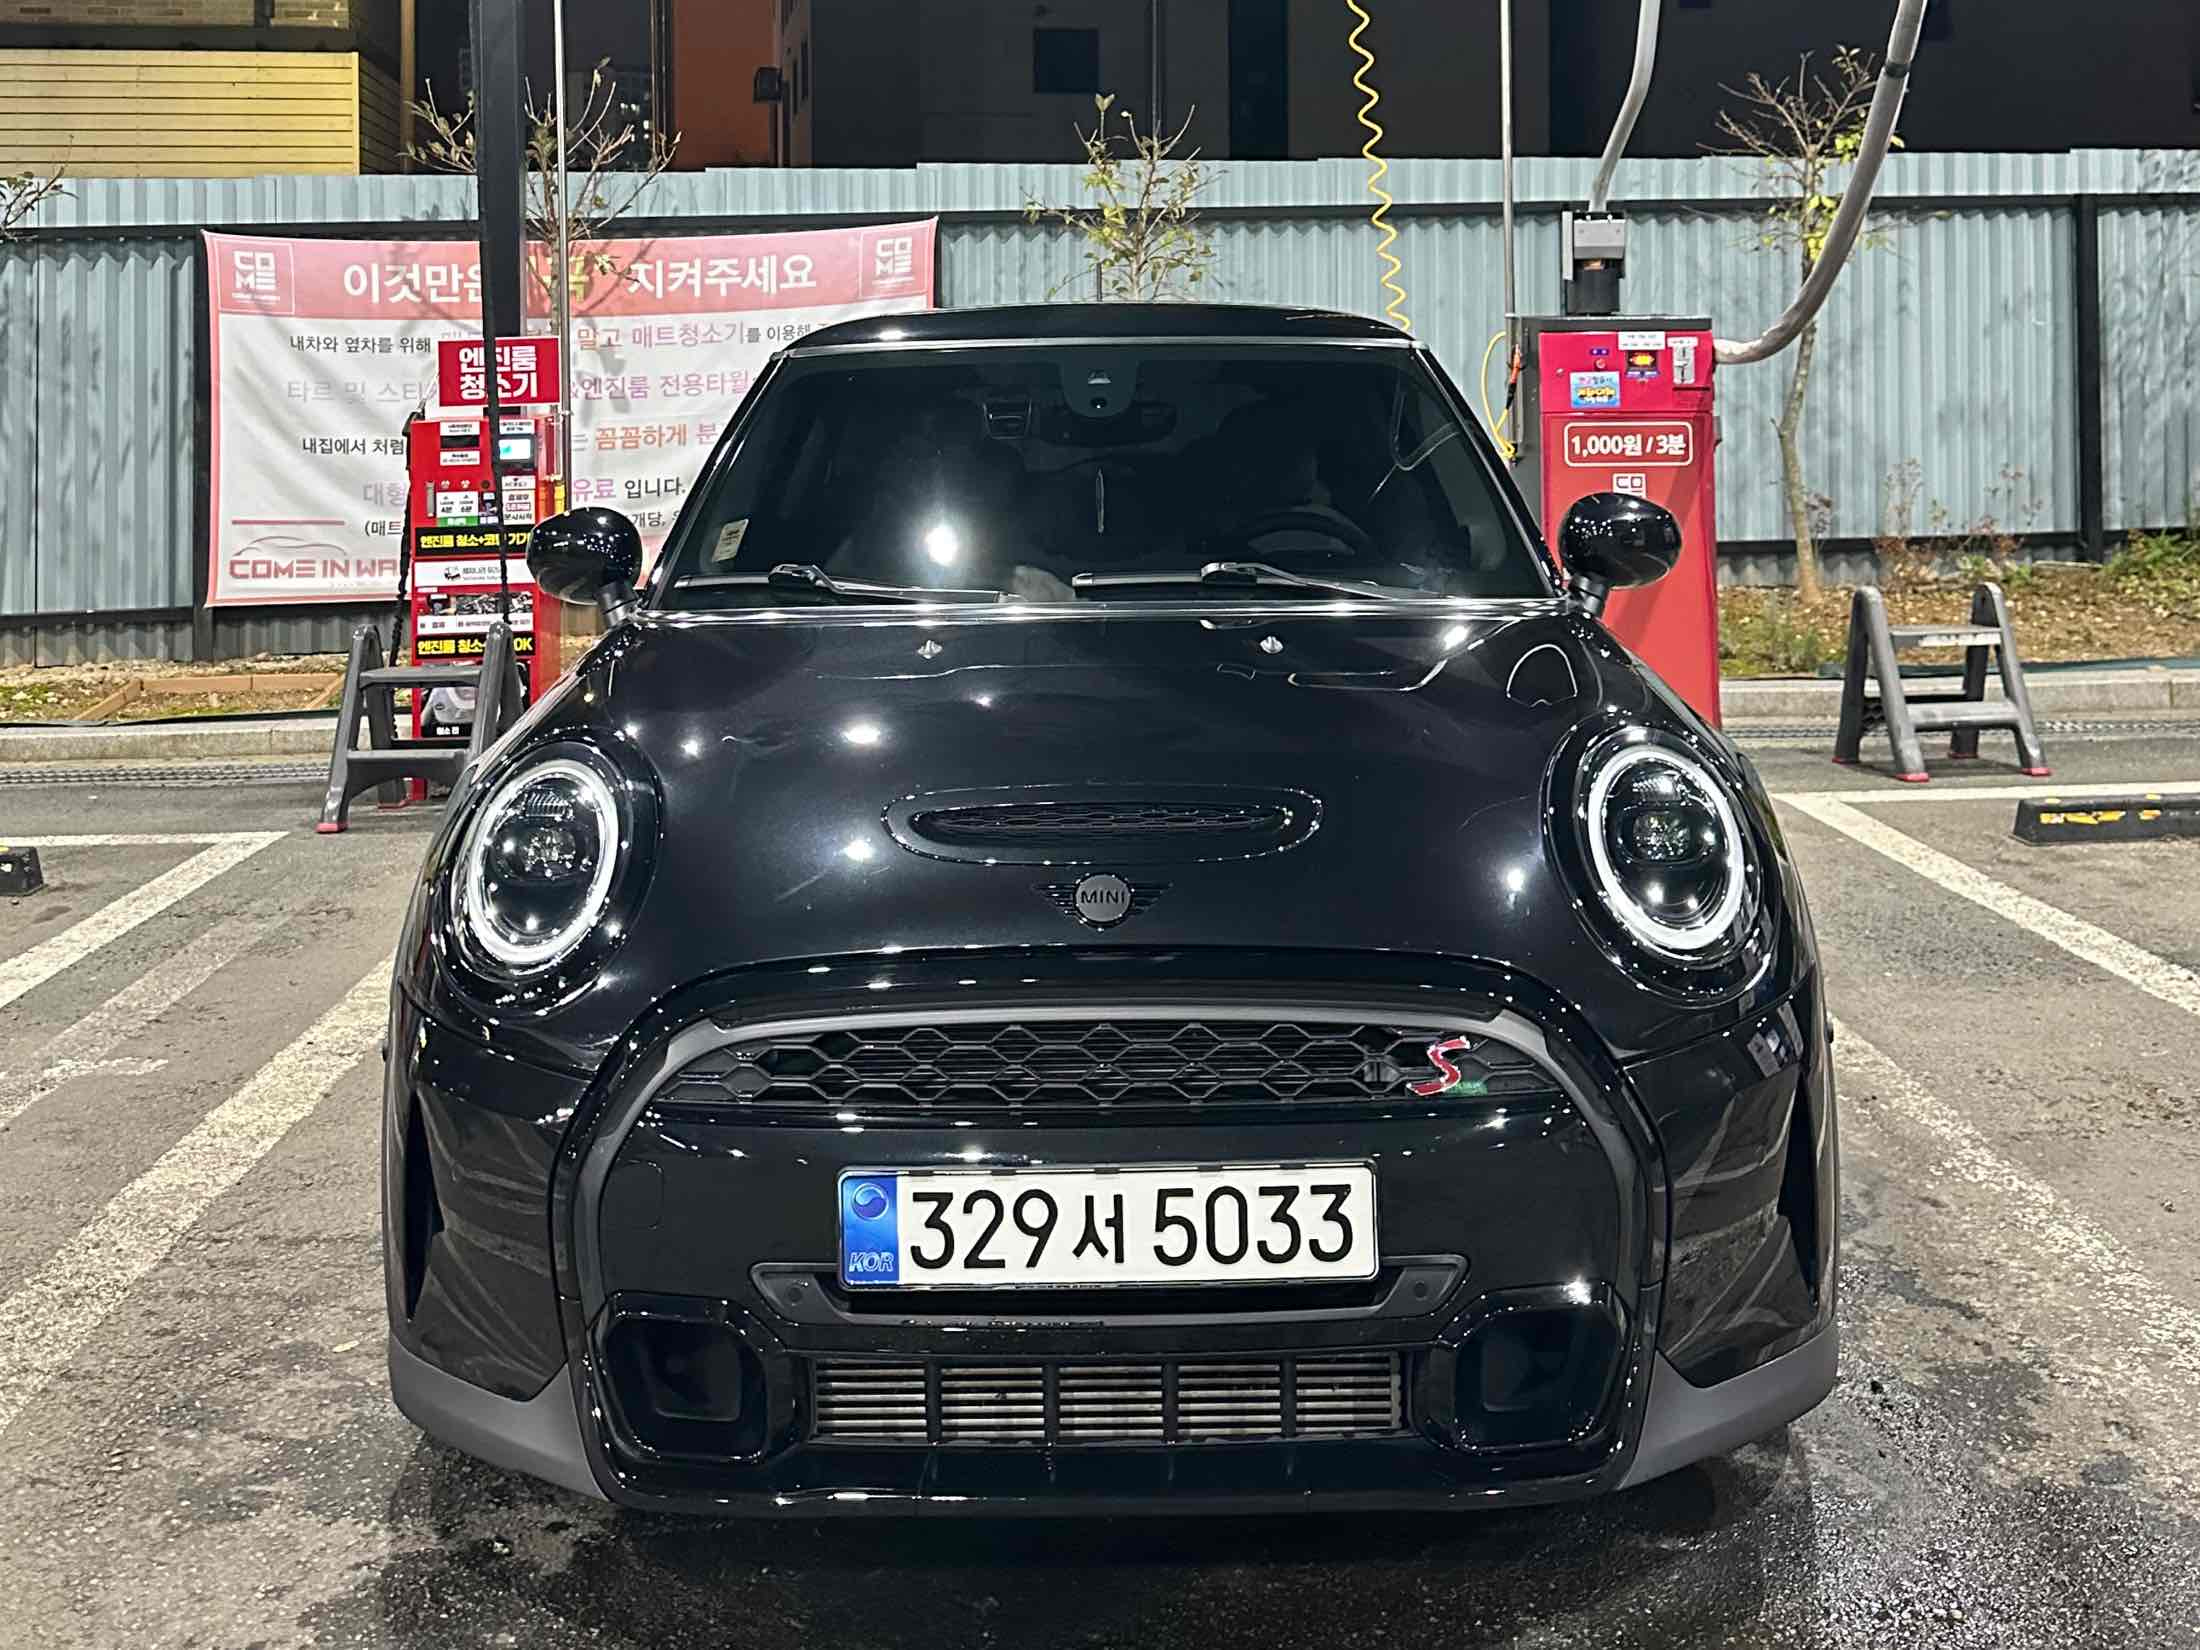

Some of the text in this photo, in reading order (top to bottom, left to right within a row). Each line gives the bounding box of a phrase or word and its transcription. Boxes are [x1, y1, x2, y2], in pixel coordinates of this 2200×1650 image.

[628, 254, 817, 299] 지켜주세요
[290, 336, 337, 353] 내차와
[345, 337, 393, 354] 옆차를
[400, 337, 431, 353] 위해
[577, 329, 623, 350] 말고
[632, 322, 761, 347] 매트청소기를
[458, 345, 537, 374] 엔진룸
[302, 438, 366, 455] 내집에서
[372, 438, 404, 455] 처럼
[596, 424, 688, 450] 꼼꼼하게
[1571, 434, 1686, 457] 1,000원 / 3분
[573, 479, 616, 502] 유료
[624, 476, 686, 499] 입니다.
[229, 559, 316, 579] COME
[322, 559, 349, 579] IN
[1081, 887, 1127, 905] MINI
[1406, 1035, 1471, 1096] S
[909, 1183, 1353, 1269] 329서 5033
[848, 1251, 895, 1273] KOR
